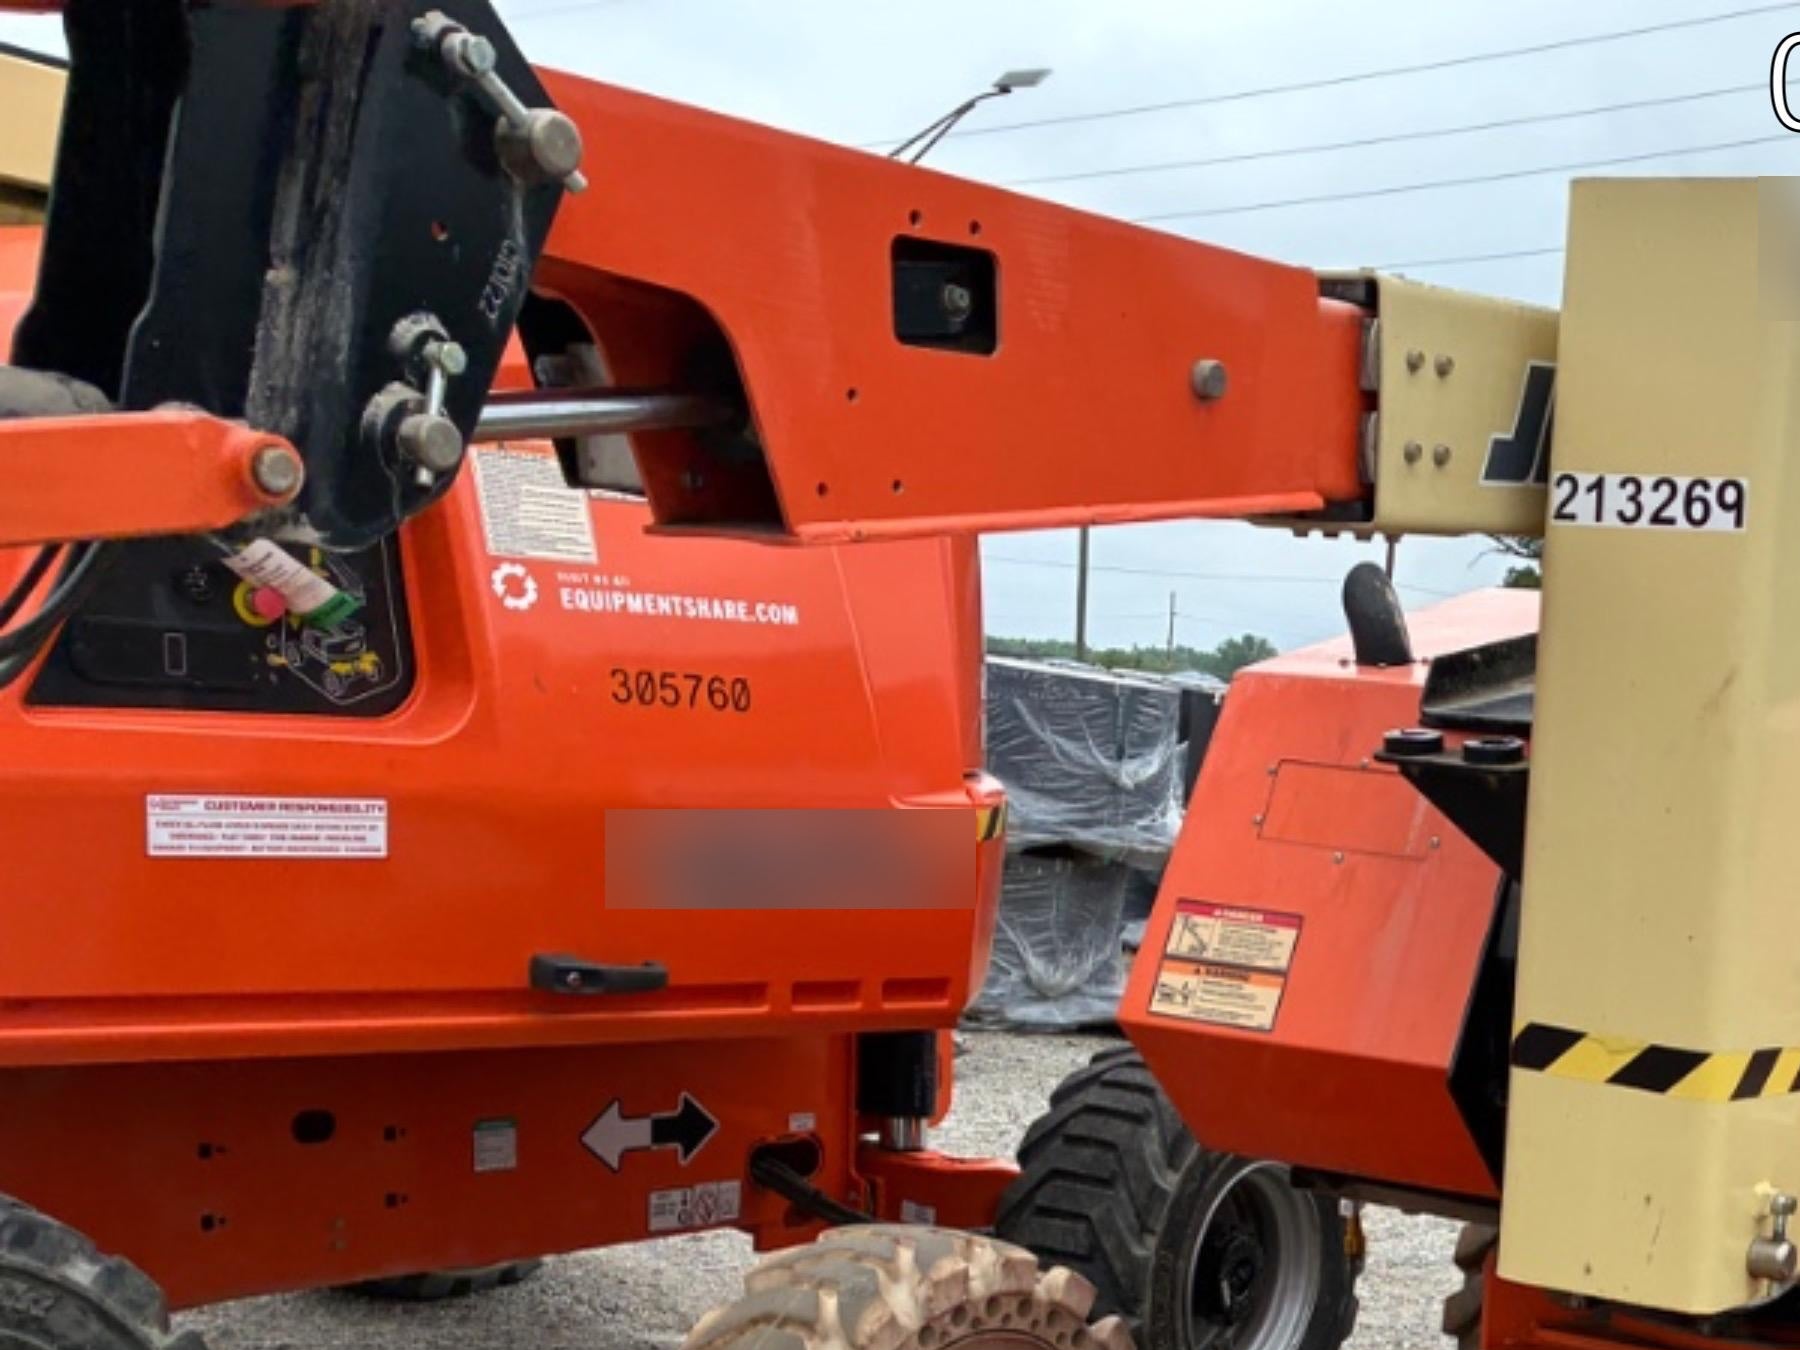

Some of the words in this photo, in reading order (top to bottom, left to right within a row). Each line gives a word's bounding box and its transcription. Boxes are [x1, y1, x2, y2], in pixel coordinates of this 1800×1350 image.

[1553, 473, 1745, 529] 213269
[559, 587, 798, 625] EQUIPMENTSHARE.COM
[610, 668, 751, 712] 305760
